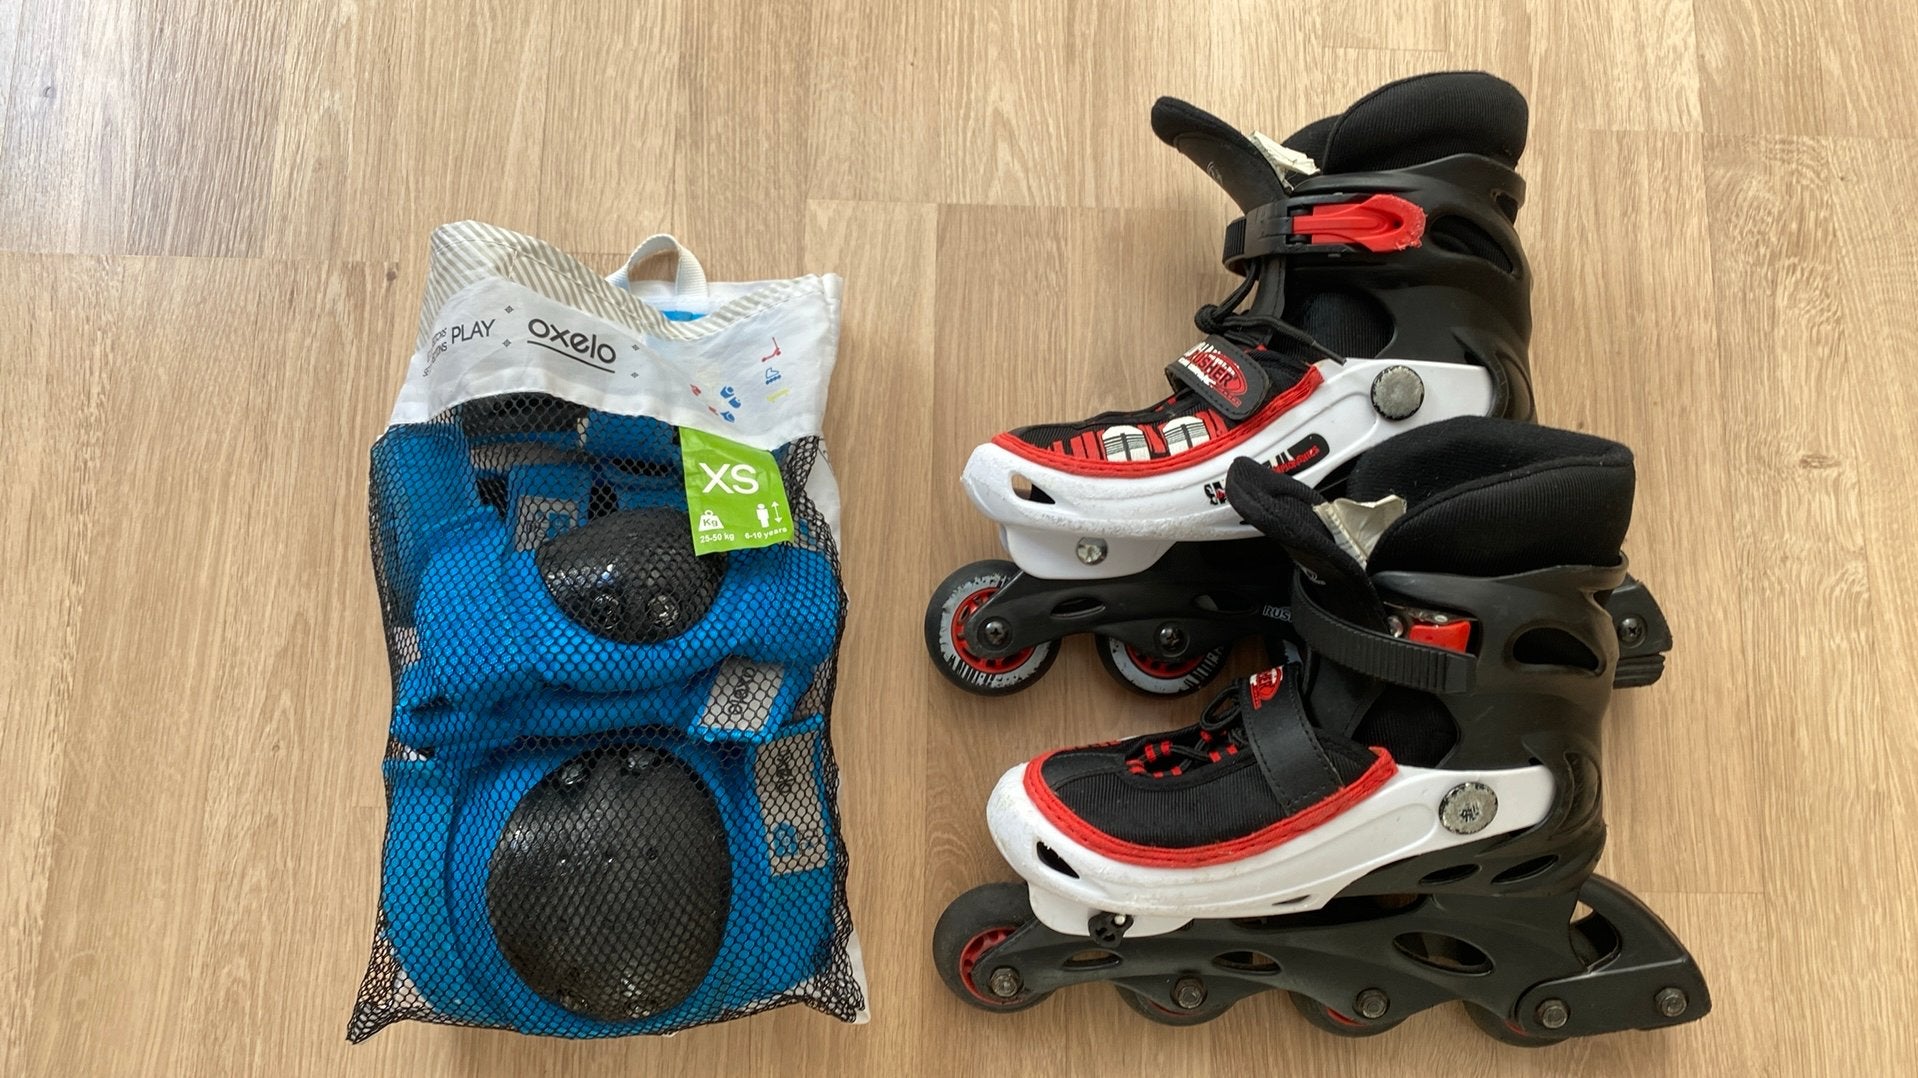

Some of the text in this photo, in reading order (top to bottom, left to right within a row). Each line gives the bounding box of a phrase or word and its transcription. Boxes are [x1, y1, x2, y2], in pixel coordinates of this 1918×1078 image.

[452, 318, 496, 344] PLAY
[528, 318, 617, 364] oxelo
[698, 462, 760, 495] XS
[703, 518, 718, 528] Kg
[699, 532, 735, 543] 25-50 kg
[744, 527, 787, 540] 6-10 years
